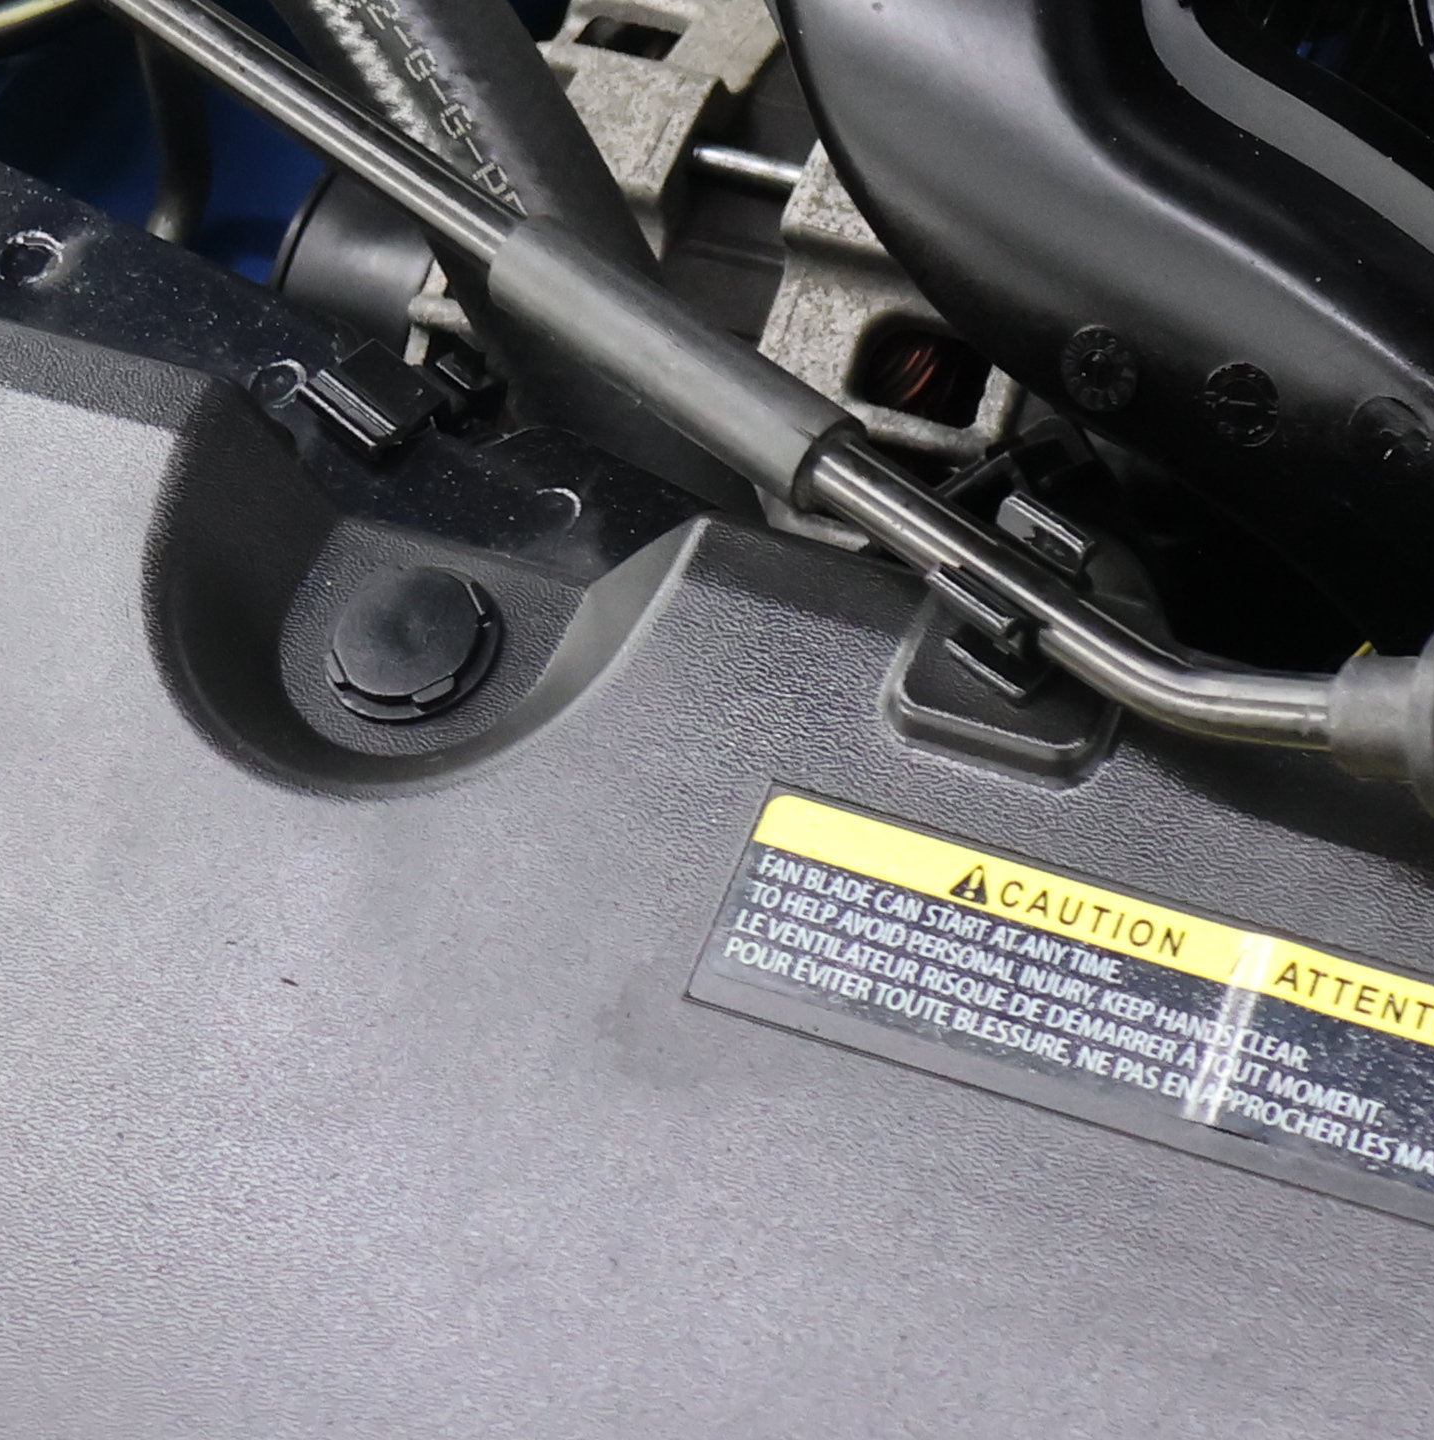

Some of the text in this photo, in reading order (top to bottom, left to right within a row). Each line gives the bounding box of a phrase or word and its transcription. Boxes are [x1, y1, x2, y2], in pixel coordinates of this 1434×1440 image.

[748, 882, 1314, 1073] TO HELP AVOID PERSONAL INJURY, KEEP HANDS CLEAR.
[757, 854, 1127, 984] FAN BLADE CAN START AT ANY TIME.
[997, 879, 1188, 958] CAUTION
[723, 938, 792, 977] POUR
[791, 954, 875, 1003] ÉVITER
[872, 982, 952, 1027] TOUTE
[951, 1007, 1077, 1067] BLESSURE,
[1076, 1044, 1115, 1075] NE
[1112, 1055, 1162, 1090] PAS
[1160, 1070, 1201, 1102] EN
[1198, 1082, 1349, 1147] APPROCHER
[1346, 1127, 1395, 1162] LES
[734, 910, 1387, 1127] LE VENTILATEUR RISQUE DE DÉMARRER À TOUT MOMENT.
